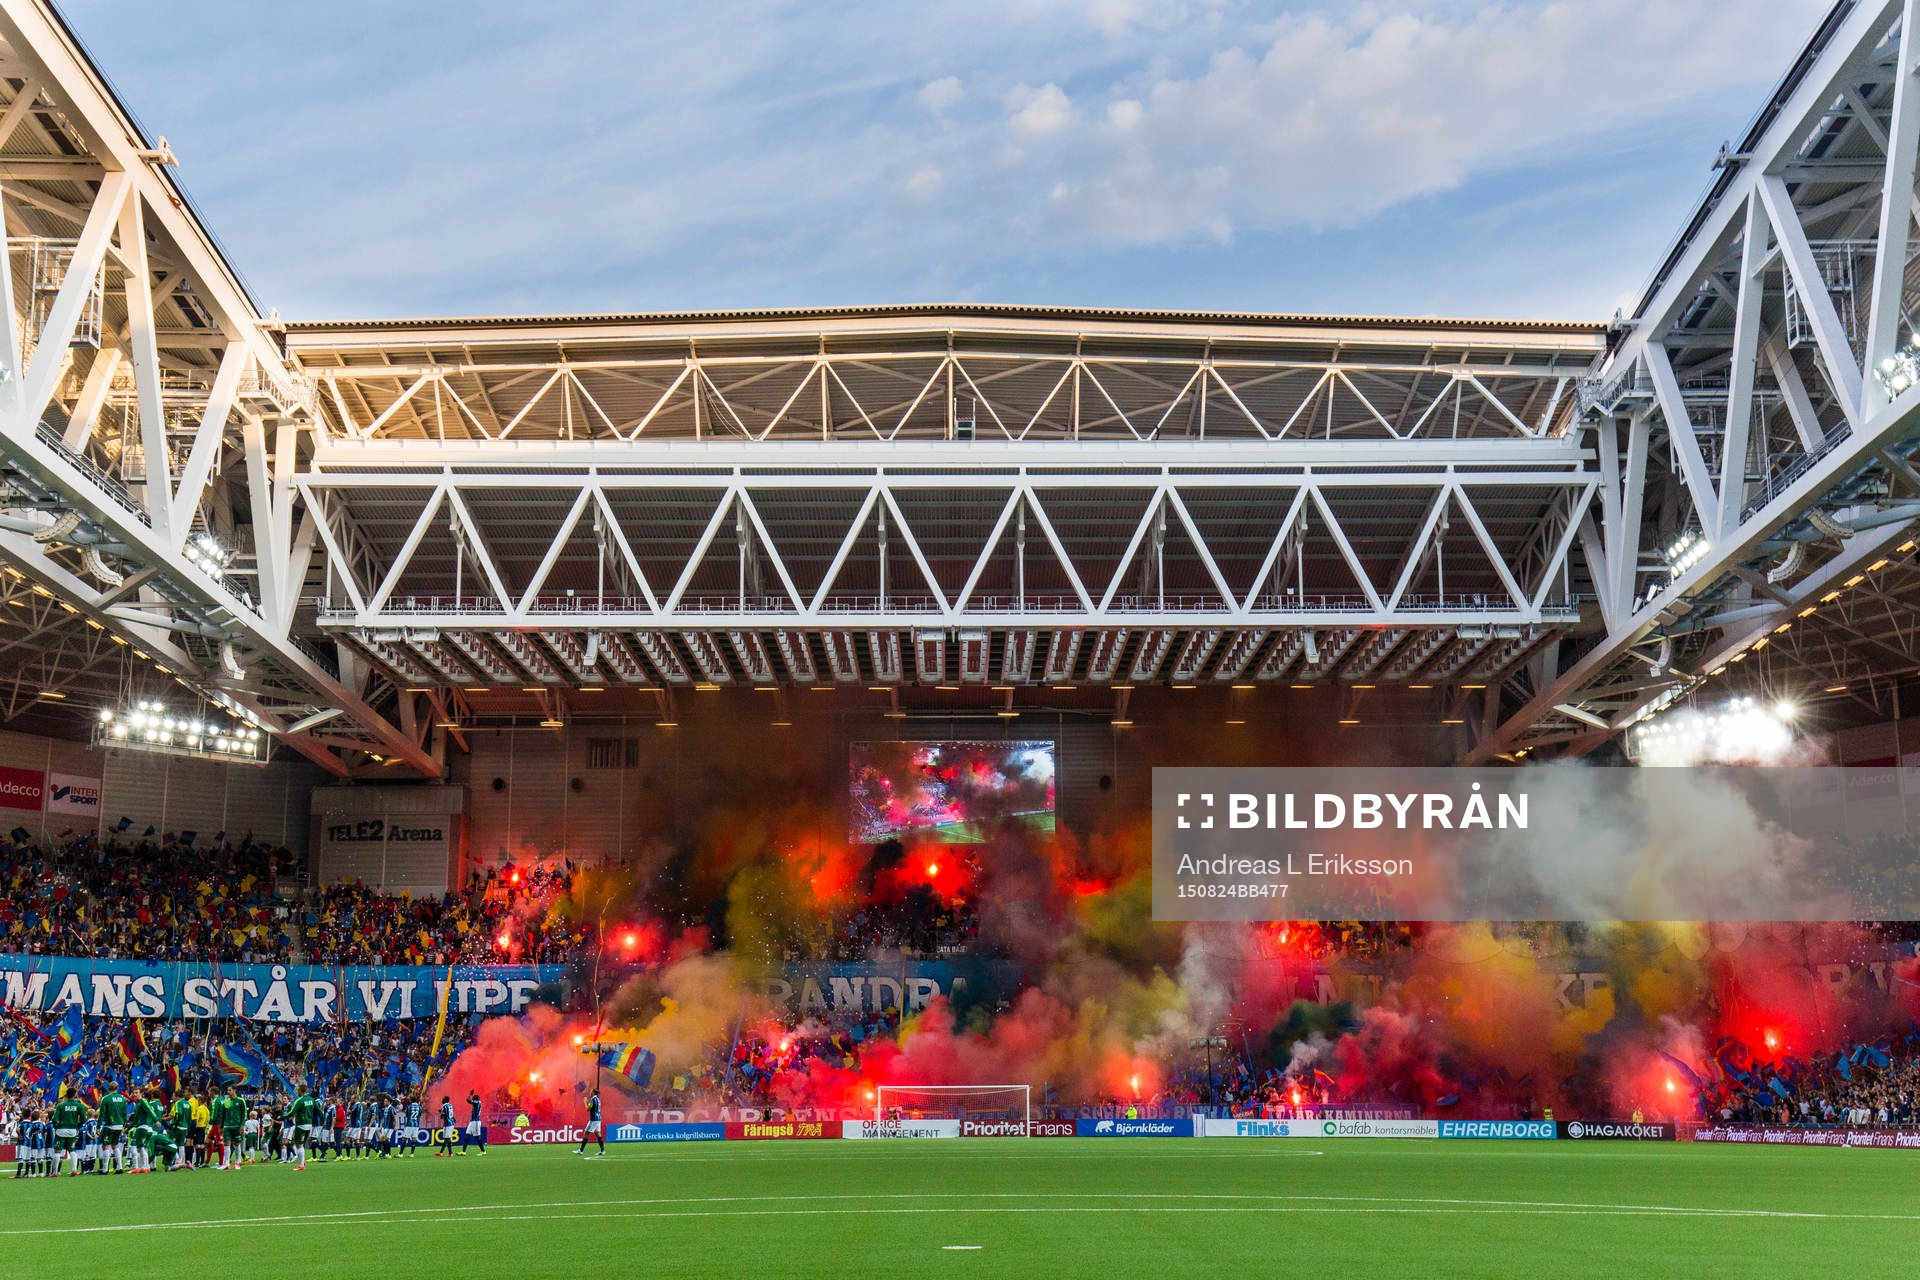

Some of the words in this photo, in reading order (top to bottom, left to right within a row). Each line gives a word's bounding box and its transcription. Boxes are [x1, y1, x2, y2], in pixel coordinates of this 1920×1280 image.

[70, 785, 98, 797] INTER
[70, 795, 98, 806] SPORT
[328, 820, 384, 842] TELE2
[387, 825, 443, 841] Arena
[0, 971, 166, 1018] MANS
[182, 965, 341, 1024] STÅR
[358, 979, 417, 1021] VI
[744, 1123, 793, 1137] Färingsö
[862, 1120, 901, 1129] OFFICE
[964, 1121, 1025, 1136] Prioritet
[1028, 1121, 1073, 1136] Finans
[1116, 1122, 1174, 1136] Björnkläder
[1237, 1121, 1289, 1136] Flinks
[1339, 1122, 1371, 1136] bafab
[1375, 1123, 1437, 1136] kontorsmöbler
[1442, 1121, 1552, 1137] EHRENBORG
[1585, 1122, 1663, 1138] HAGAKÖKET
[511, 1125, 584, 1143] Scandic
[645, 1131, 674, 1141] Grekiska
[676, 1130, 720, 1141] kolgrillsbaren
[862, 1129, 940, 1138] MANAGEMENT
[1762, 1129, 1786, 1143] Prioritet
[1802, 1130, 1827, 1144] Prioritet
[1826, 1131, 1846, 1145] Finans
[1846, 1131, 1874, 1145] Prioritet
[1873, 1131, 1893, 1146] Finans
